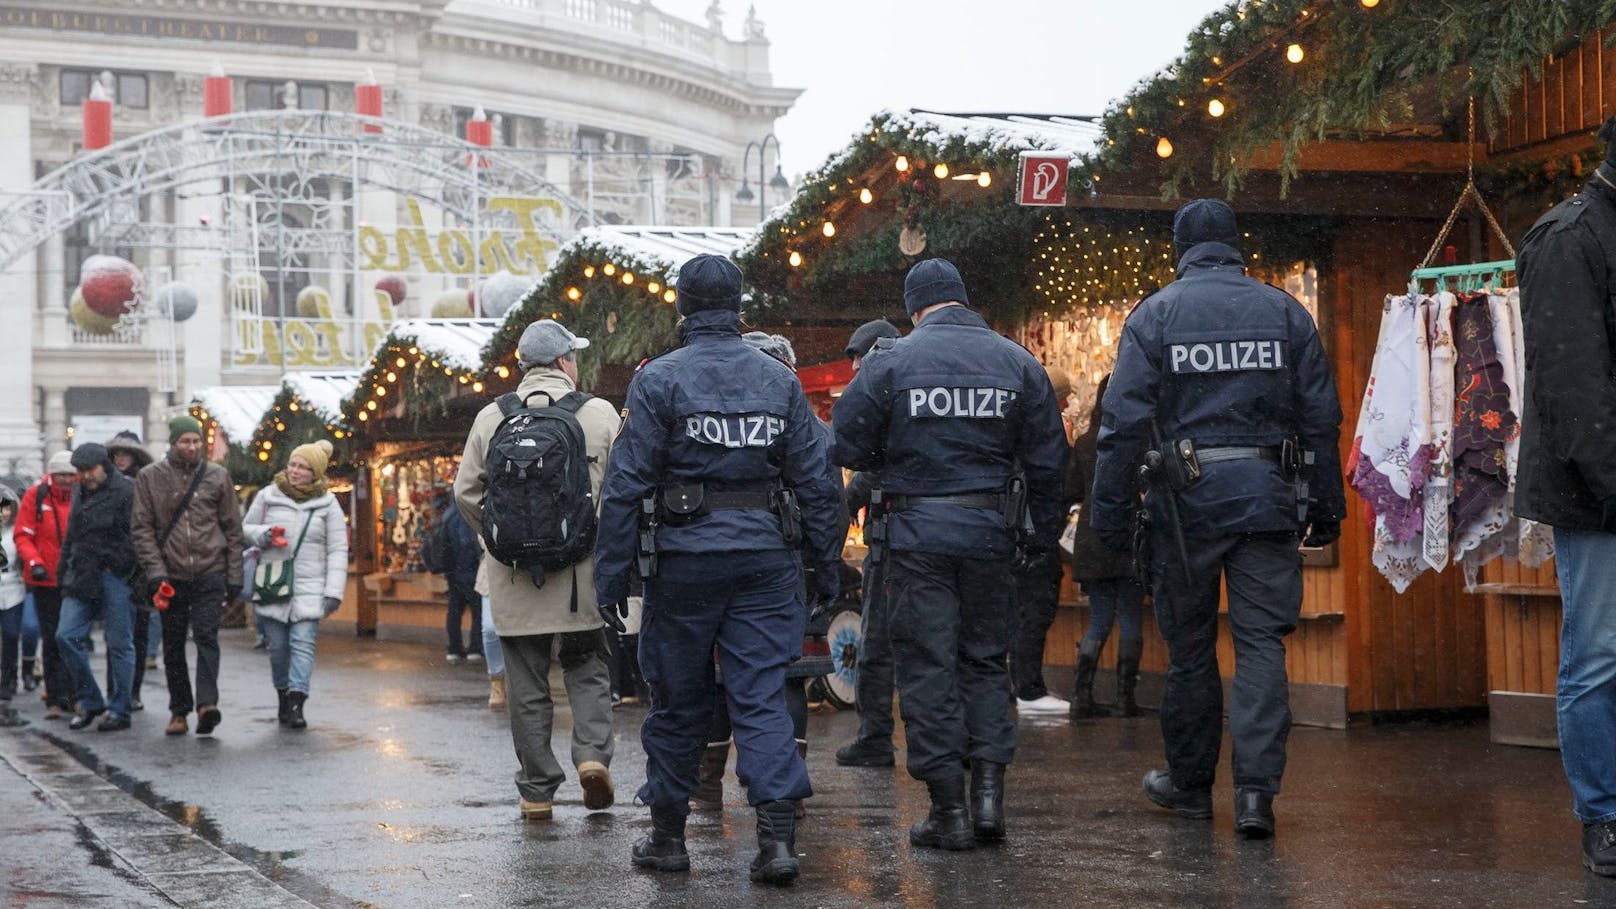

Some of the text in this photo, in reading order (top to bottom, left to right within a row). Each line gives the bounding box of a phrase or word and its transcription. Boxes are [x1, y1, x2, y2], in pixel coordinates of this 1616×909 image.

[0, 9, 271, 41] OFBURGTHEATER
[1171, 341, 1282, 372] POLIZEI
[909, 387, 1017, 418] POLIZE
